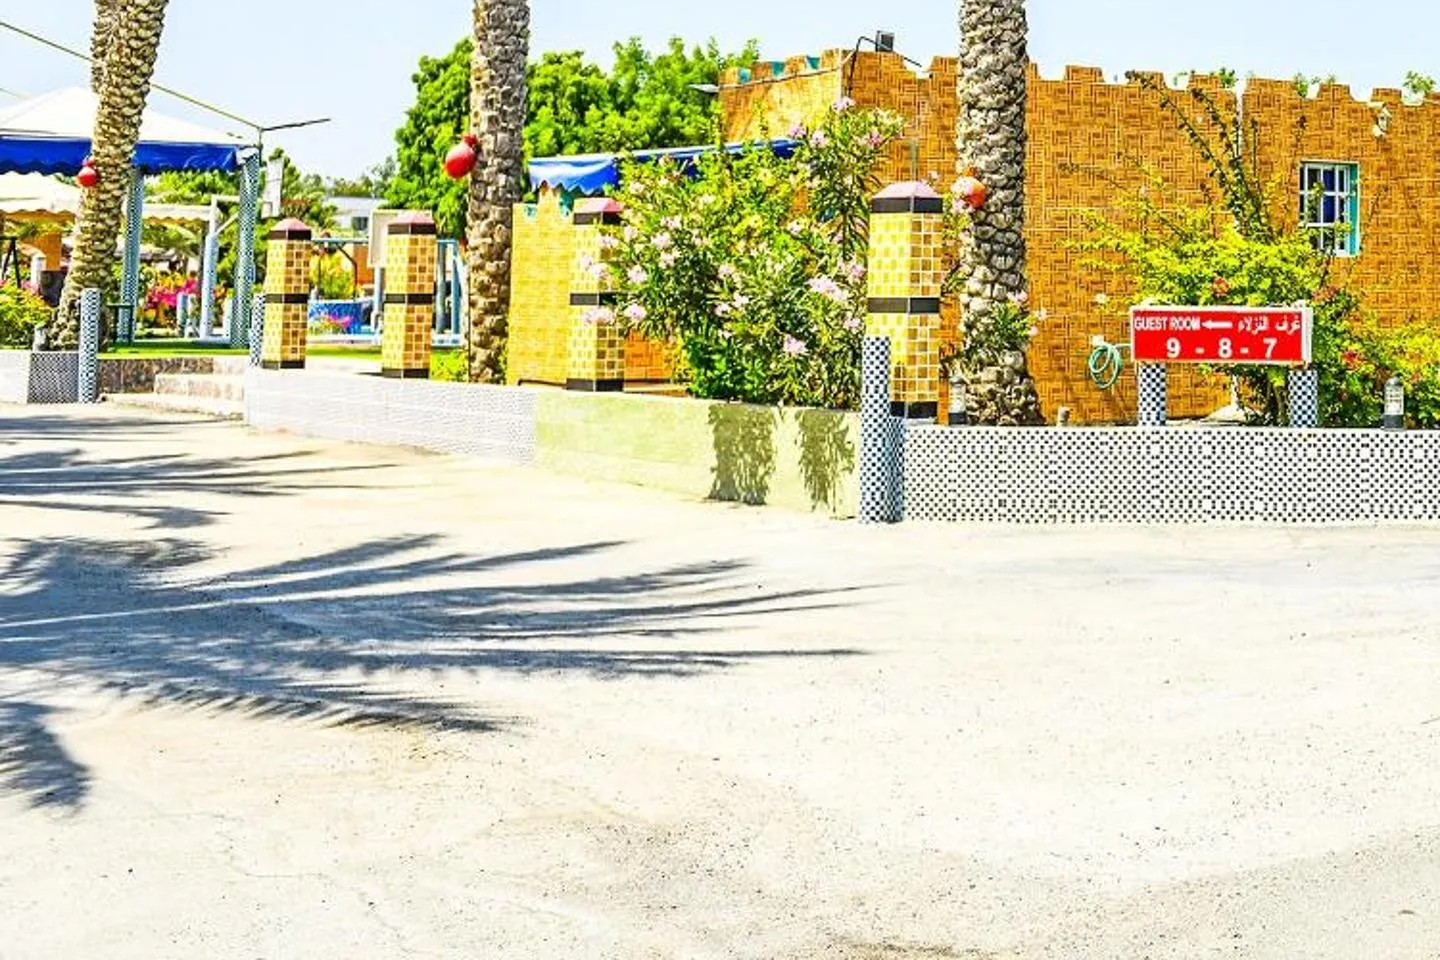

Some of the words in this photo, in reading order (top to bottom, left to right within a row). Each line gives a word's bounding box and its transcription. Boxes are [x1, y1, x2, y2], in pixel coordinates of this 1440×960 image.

[1134, 316, 1168, 331] GUEST
[1171, 316, 1201, 331] ROOM
[1237, 315, 1269, 335] النزلاء
[1275, 315, 1301, 336] غرف
[1166, 337, 1181, 359] 9
[1218, 337, 1233, 359] 8
[1262, 338, 1278, 359] 7
